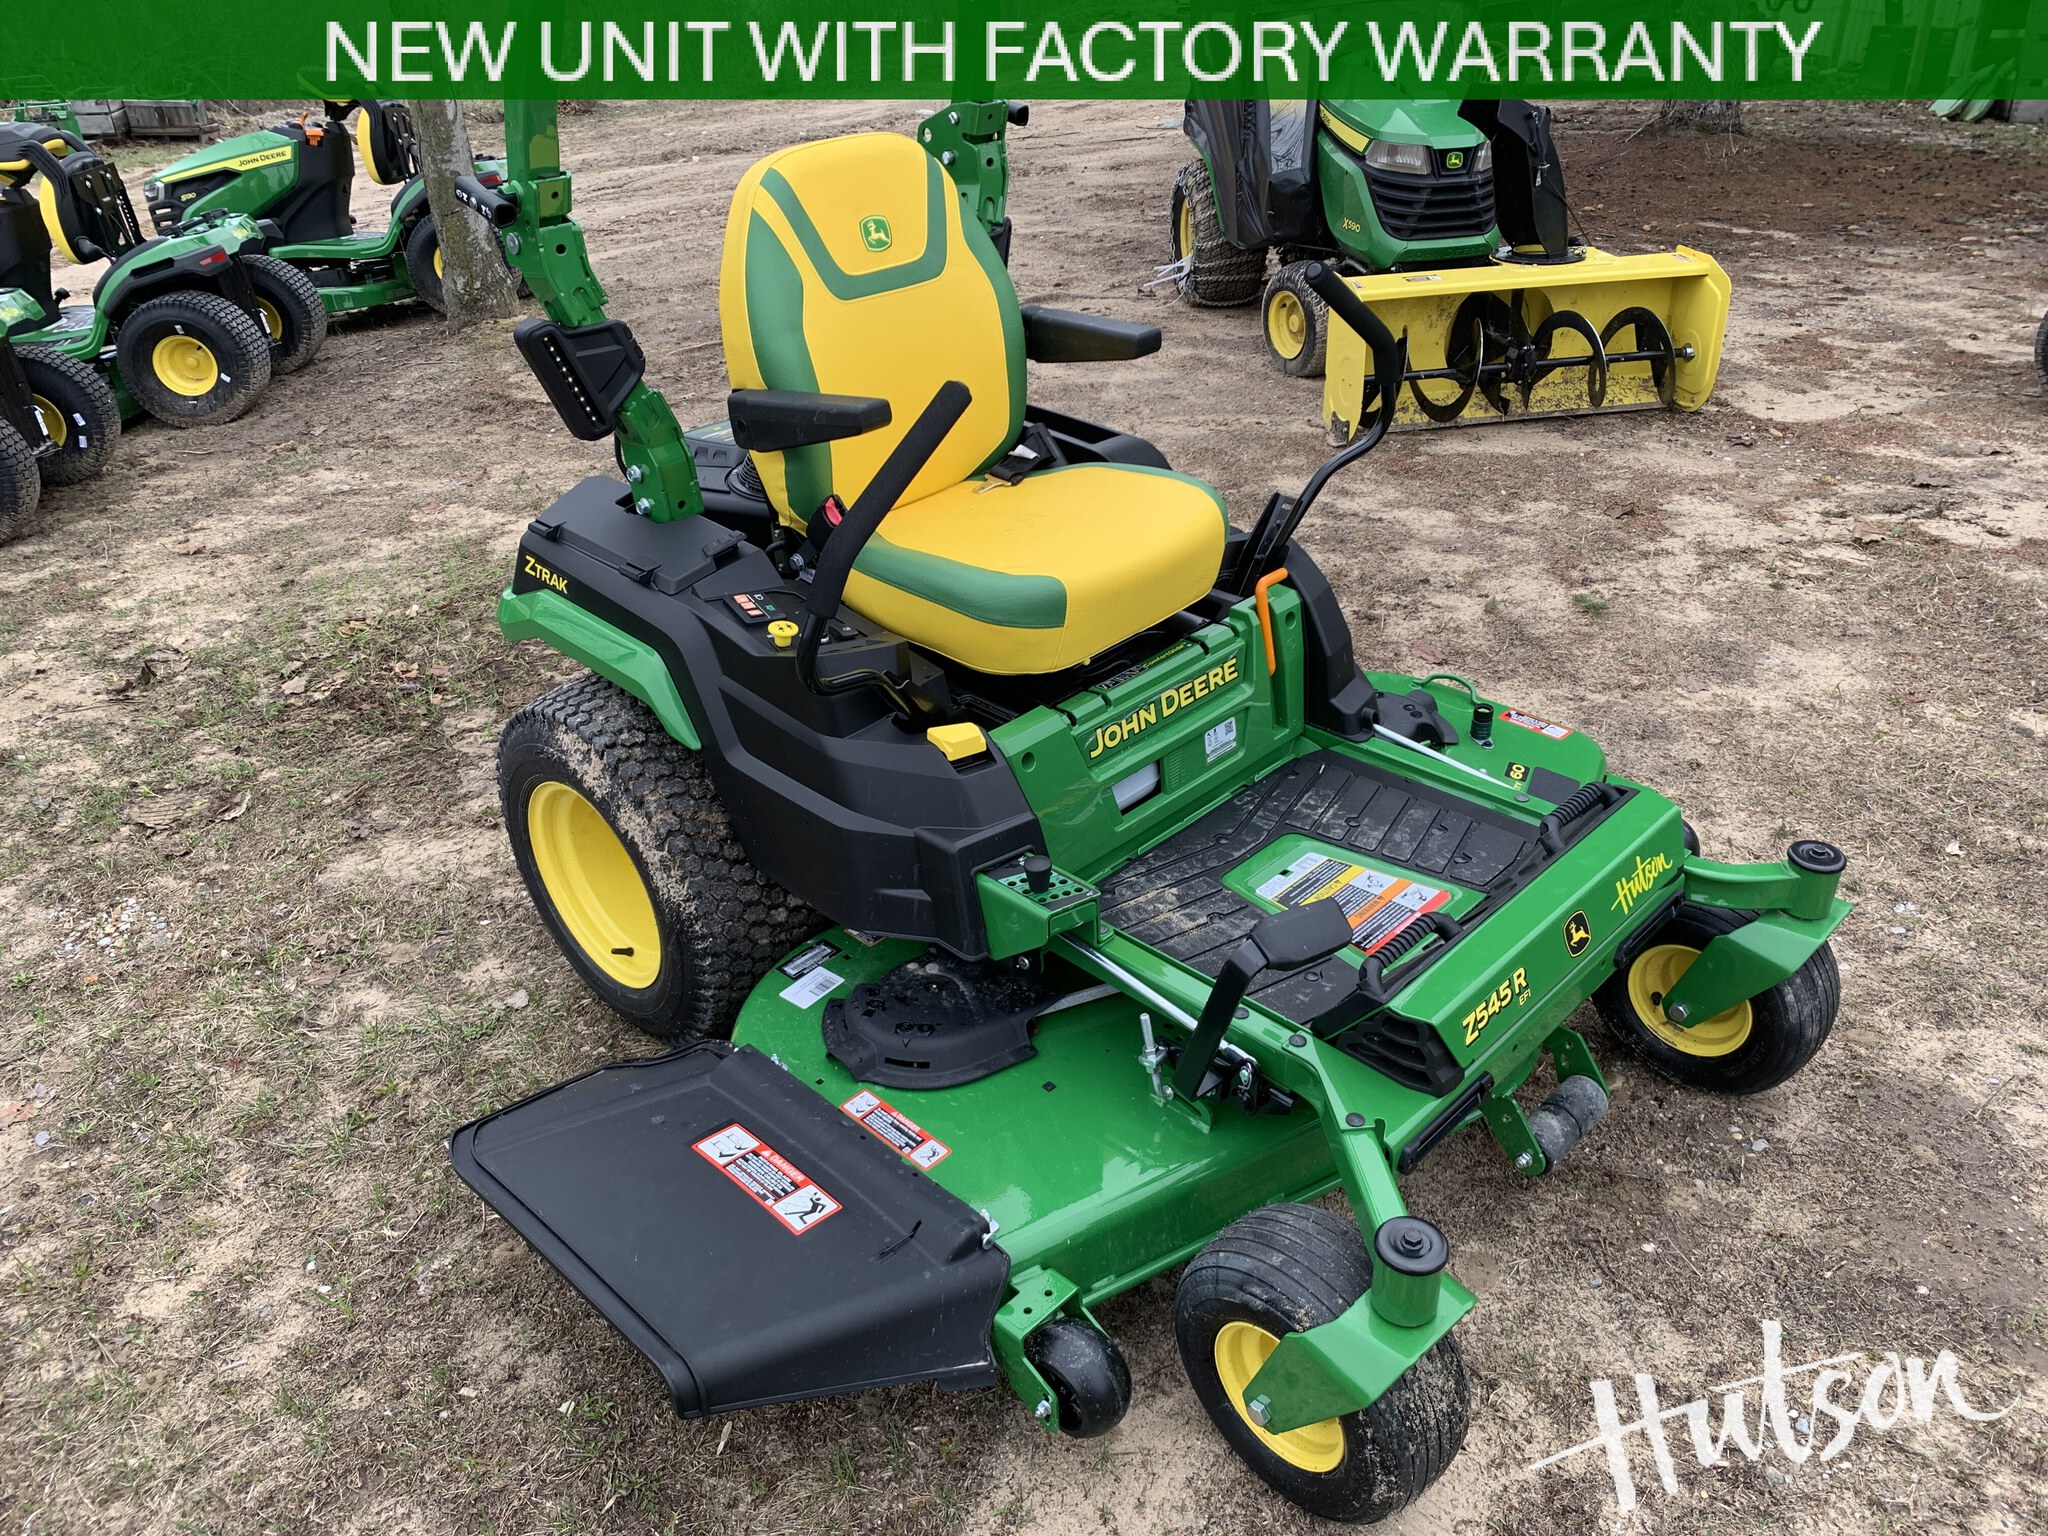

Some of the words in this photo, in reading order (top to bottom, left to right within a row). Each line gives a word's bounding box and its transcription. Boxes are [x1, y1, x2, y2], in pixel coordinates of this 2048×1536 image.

[238, 157, 259, 167] JOHN
[259, 151, 287, 162] DEERE
[1342, 217, 1361, 233] X590
[524, 555, 569, 595] ZTRAK
[1089, 702, 1159, 760] JOHN
[1159, 657, 1239, 719] DEERE
[1509, 764, 1526, 780] 60
[1610, 852, 1673, 916] Hutson
[1518, 988, 1532, 1006] EFI
[769, 1154, 805, 1182] DANGER
